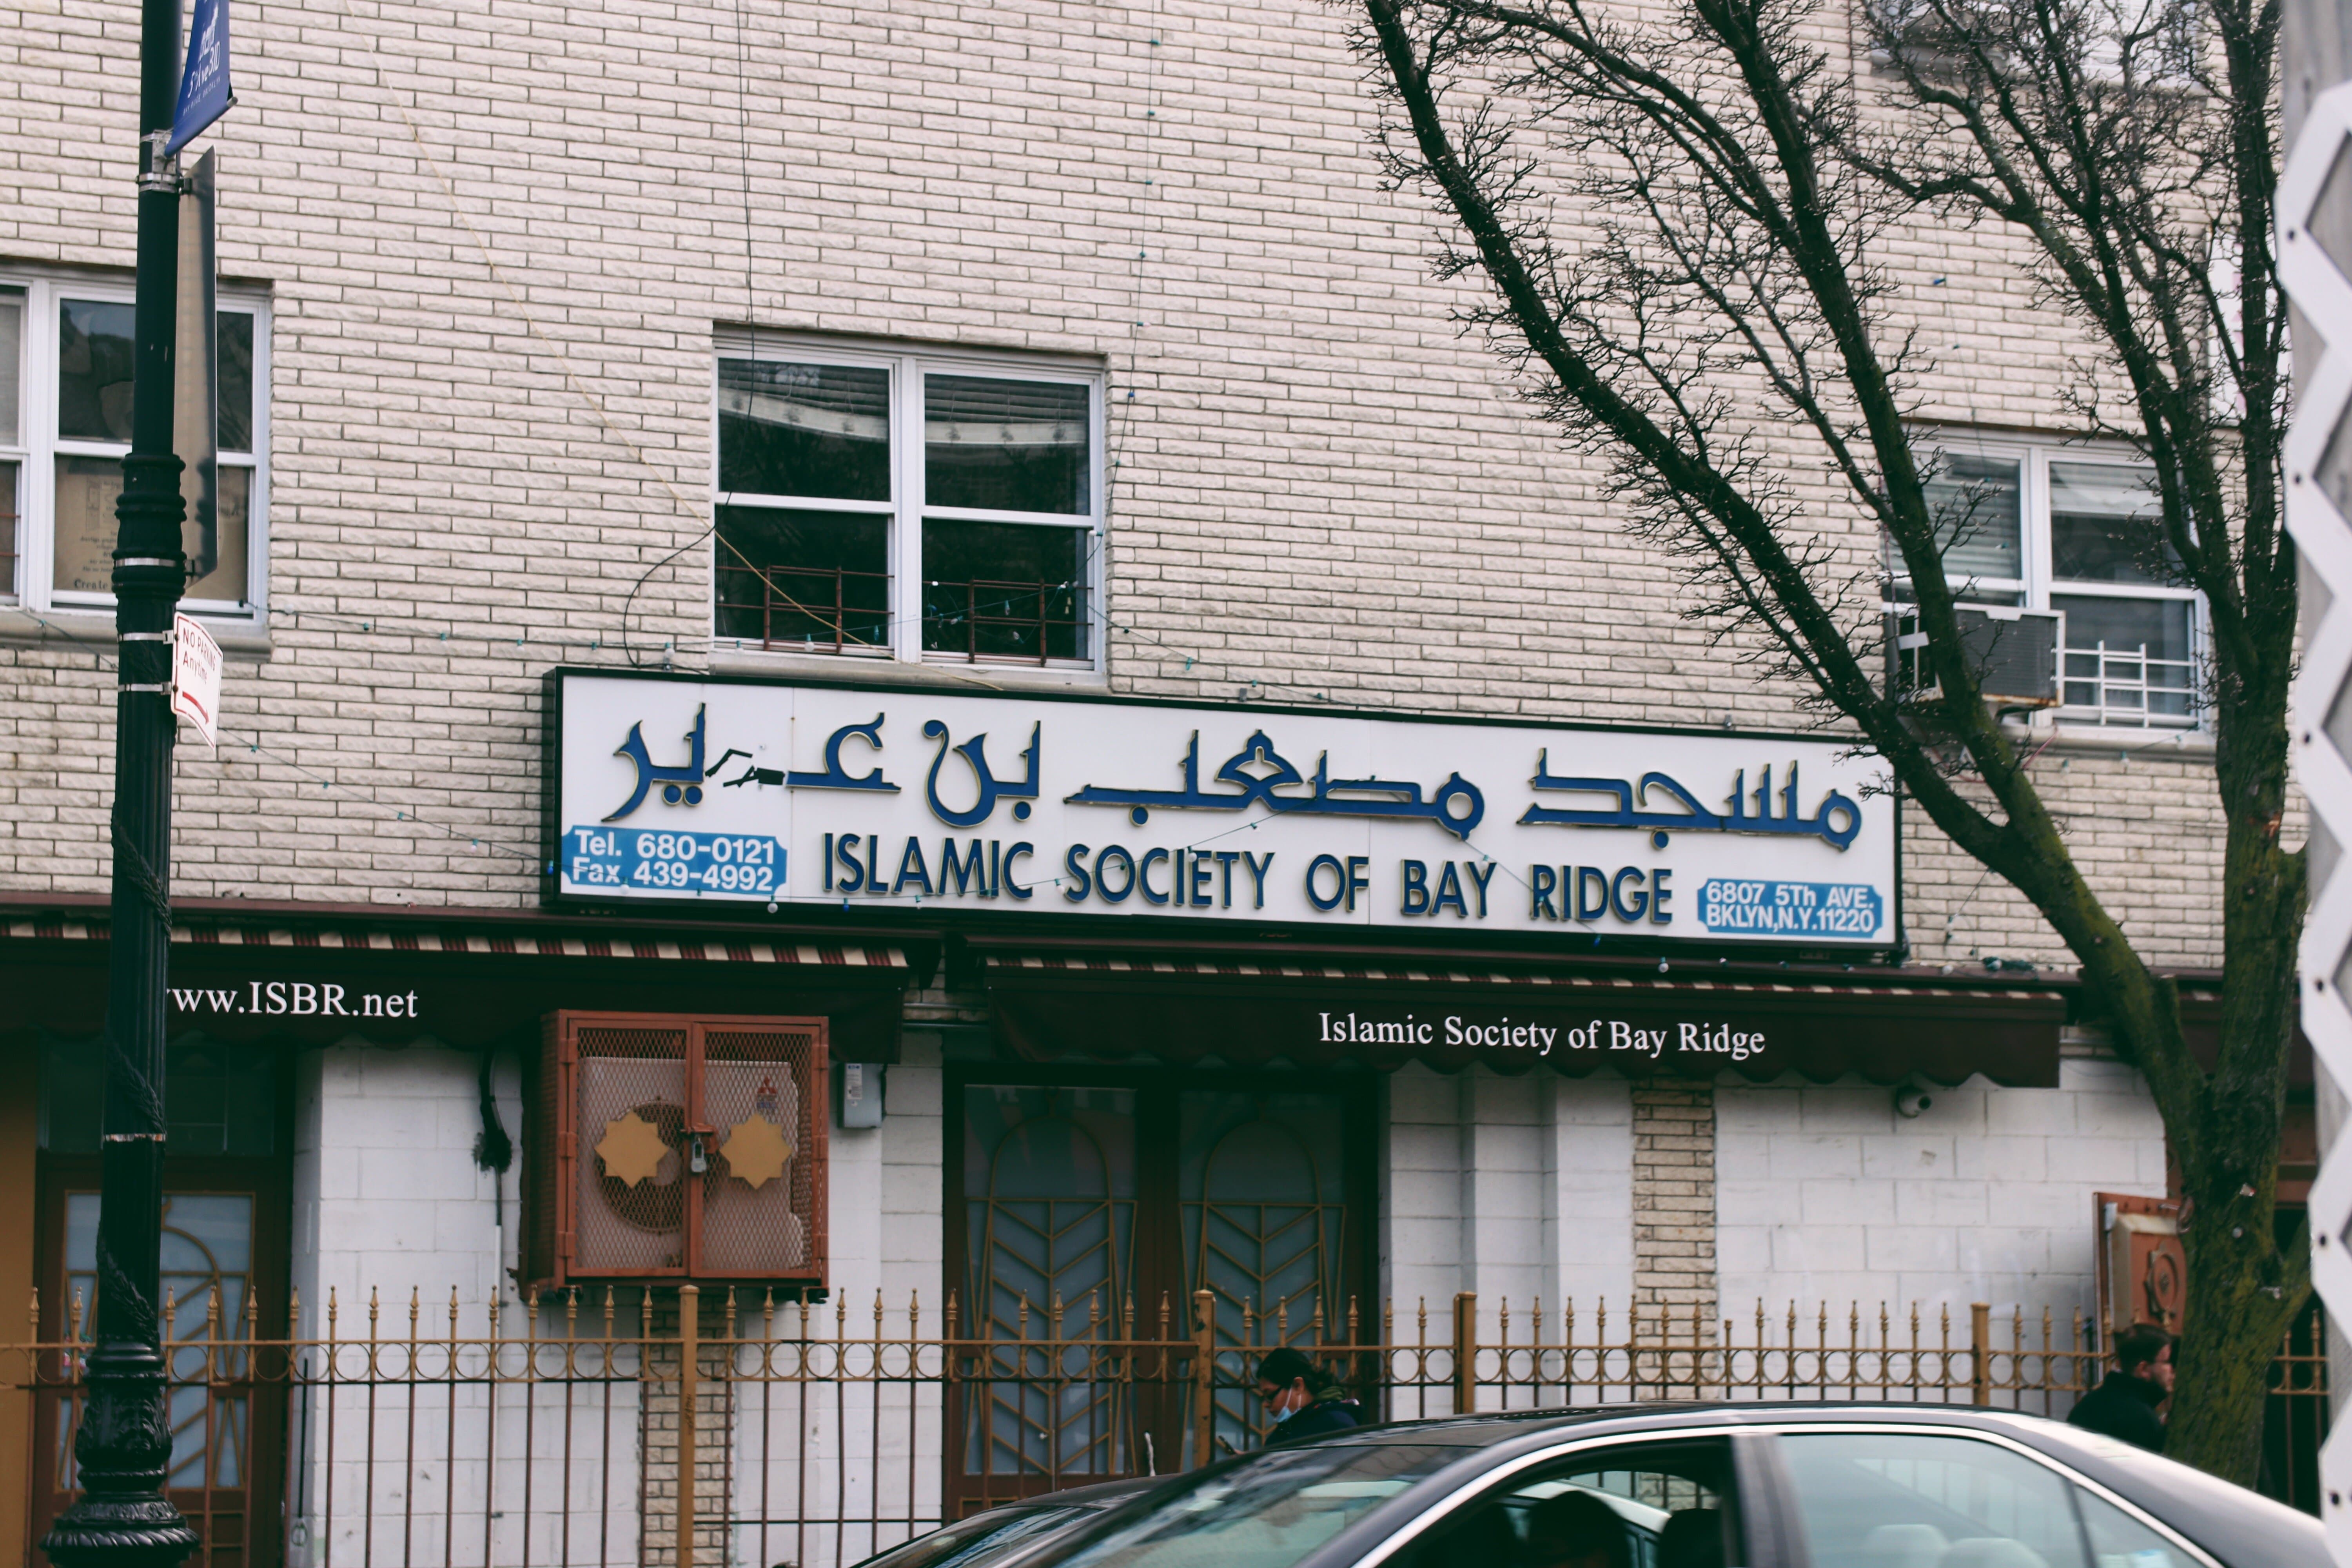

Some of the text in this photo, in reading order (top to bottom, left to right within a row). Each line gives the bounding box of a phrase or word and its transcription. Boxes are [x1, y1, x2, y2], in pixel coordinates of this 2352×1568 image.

[183, 627, 216, 671] NO PARKING
[183, 651, 207, 684] Anytime
[601, 702, 1862, 852] مسجد مصعب بن عير
[574, 829, 774, 865] Tel. 680-0121
[573, 857, 773, 891] Fax 439-4992
[823, 833, 1673, 926] ISLAMIC SOCIETY OF BAY RIDGE
[1706, 881, 1875, 909] 6807 5Th AVE.
[167, 981, 418, 1018] ww.ISBR.net
[1319, 1012, 1765, 1060] Islamic Society of Bay Ridge
